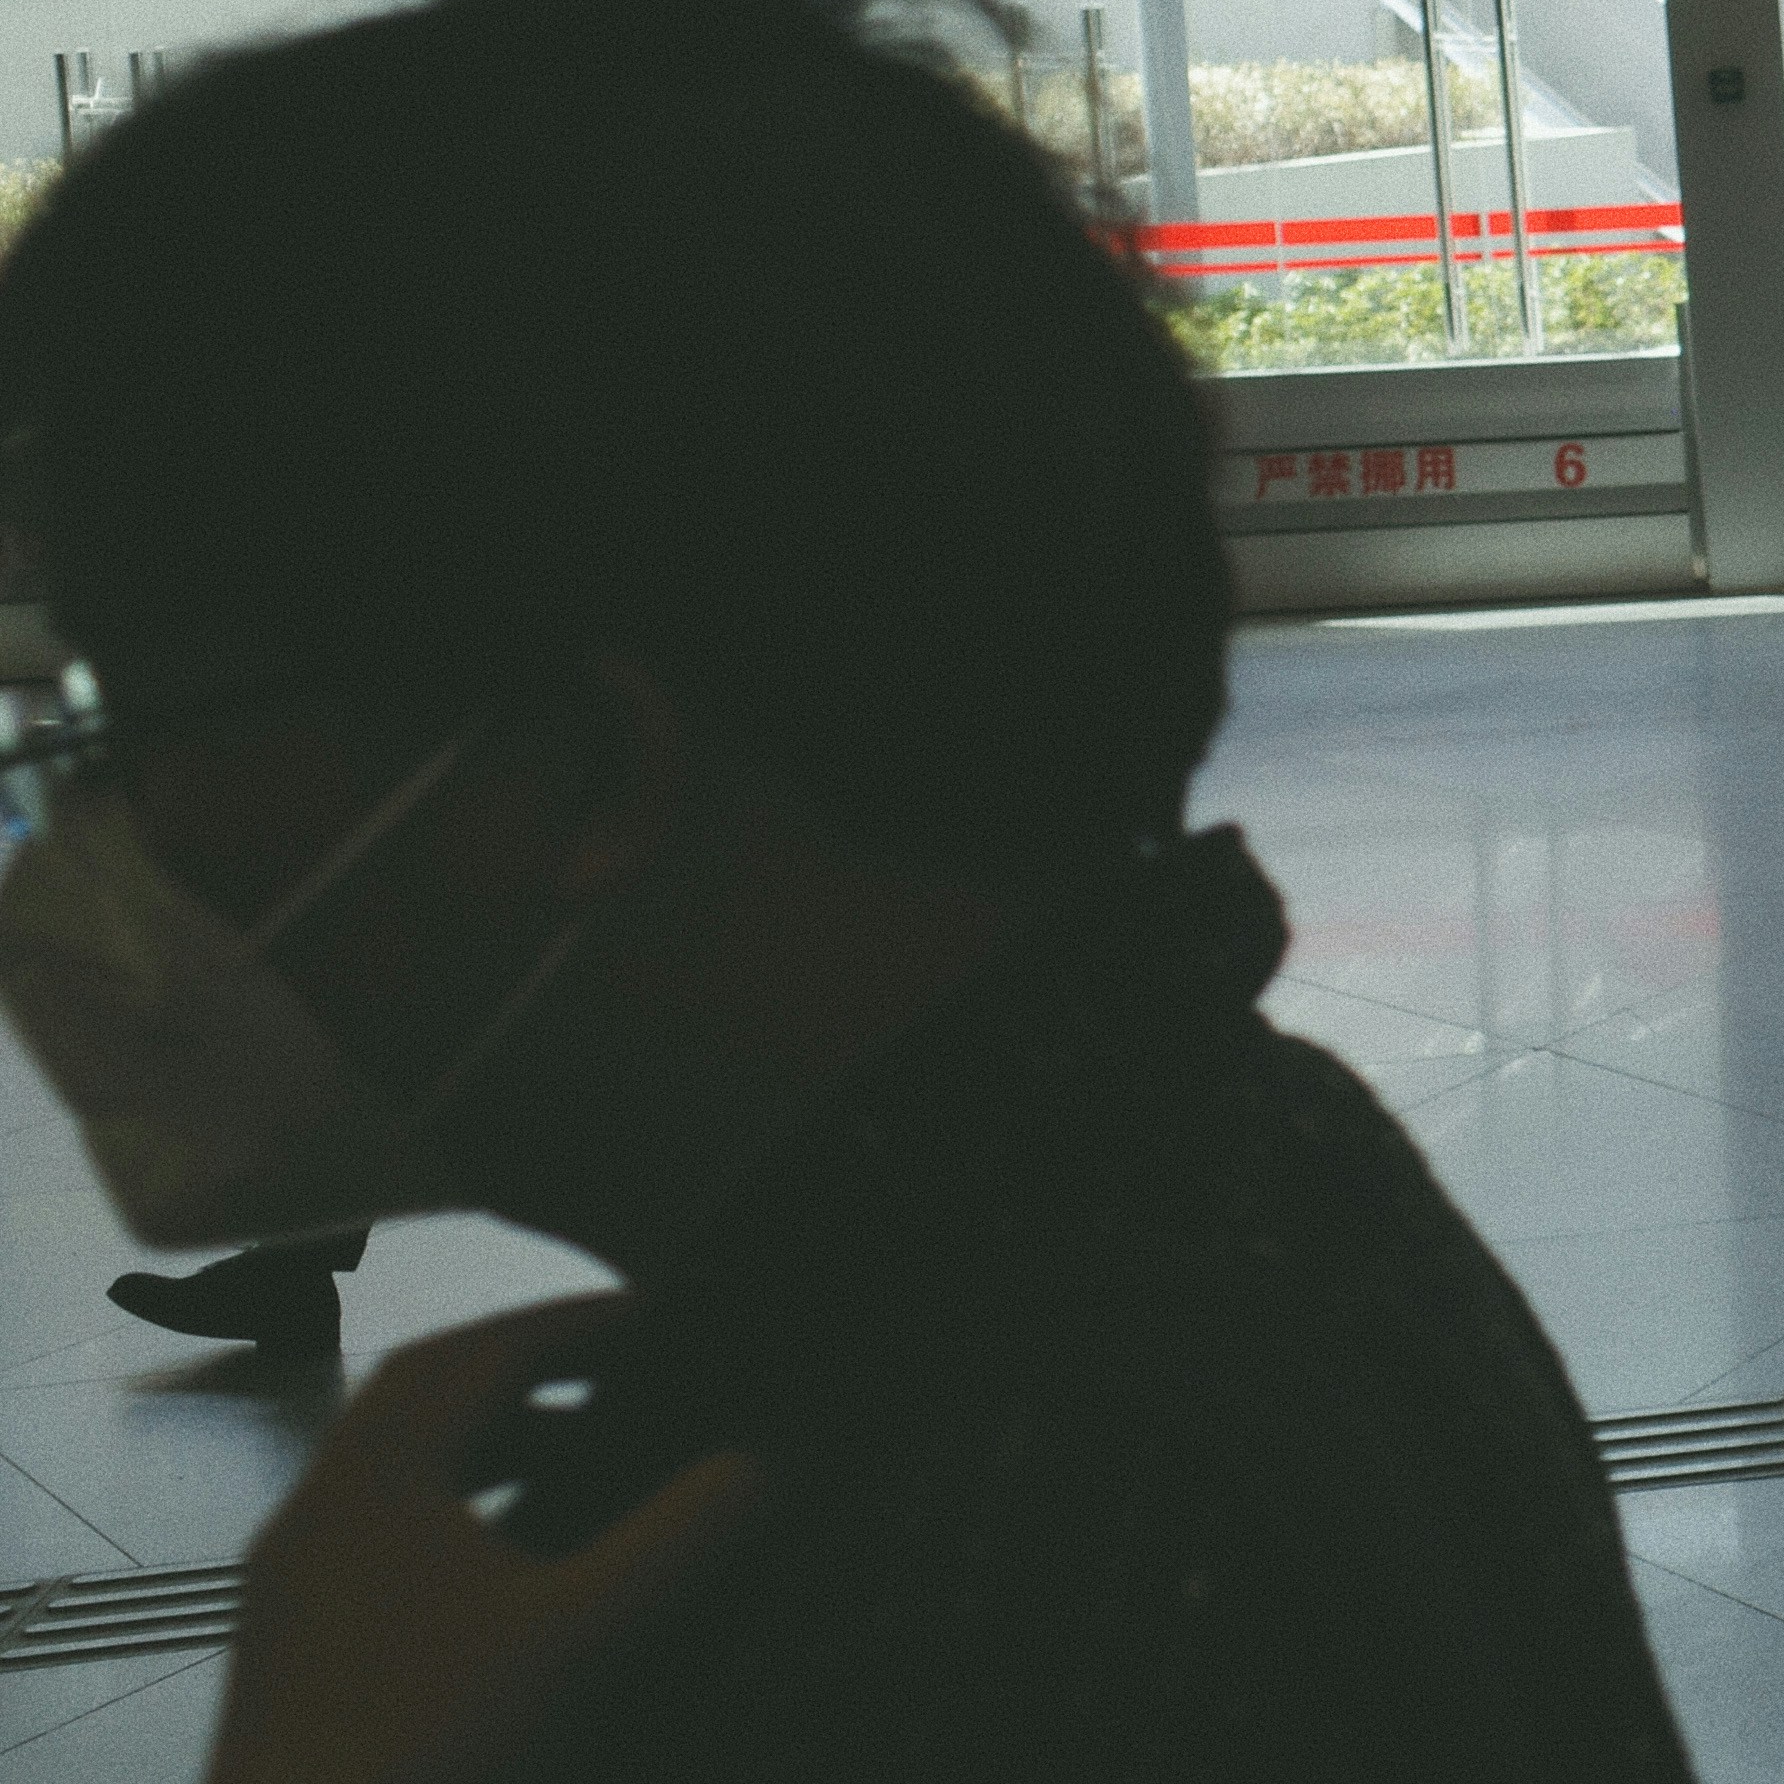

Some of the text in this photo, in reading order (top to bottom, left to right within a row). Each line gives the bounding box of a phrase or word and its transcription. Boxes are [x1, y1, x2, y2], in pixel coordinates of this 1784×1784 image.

[1256, 442, 1588, 499] 严禁挪用 6
